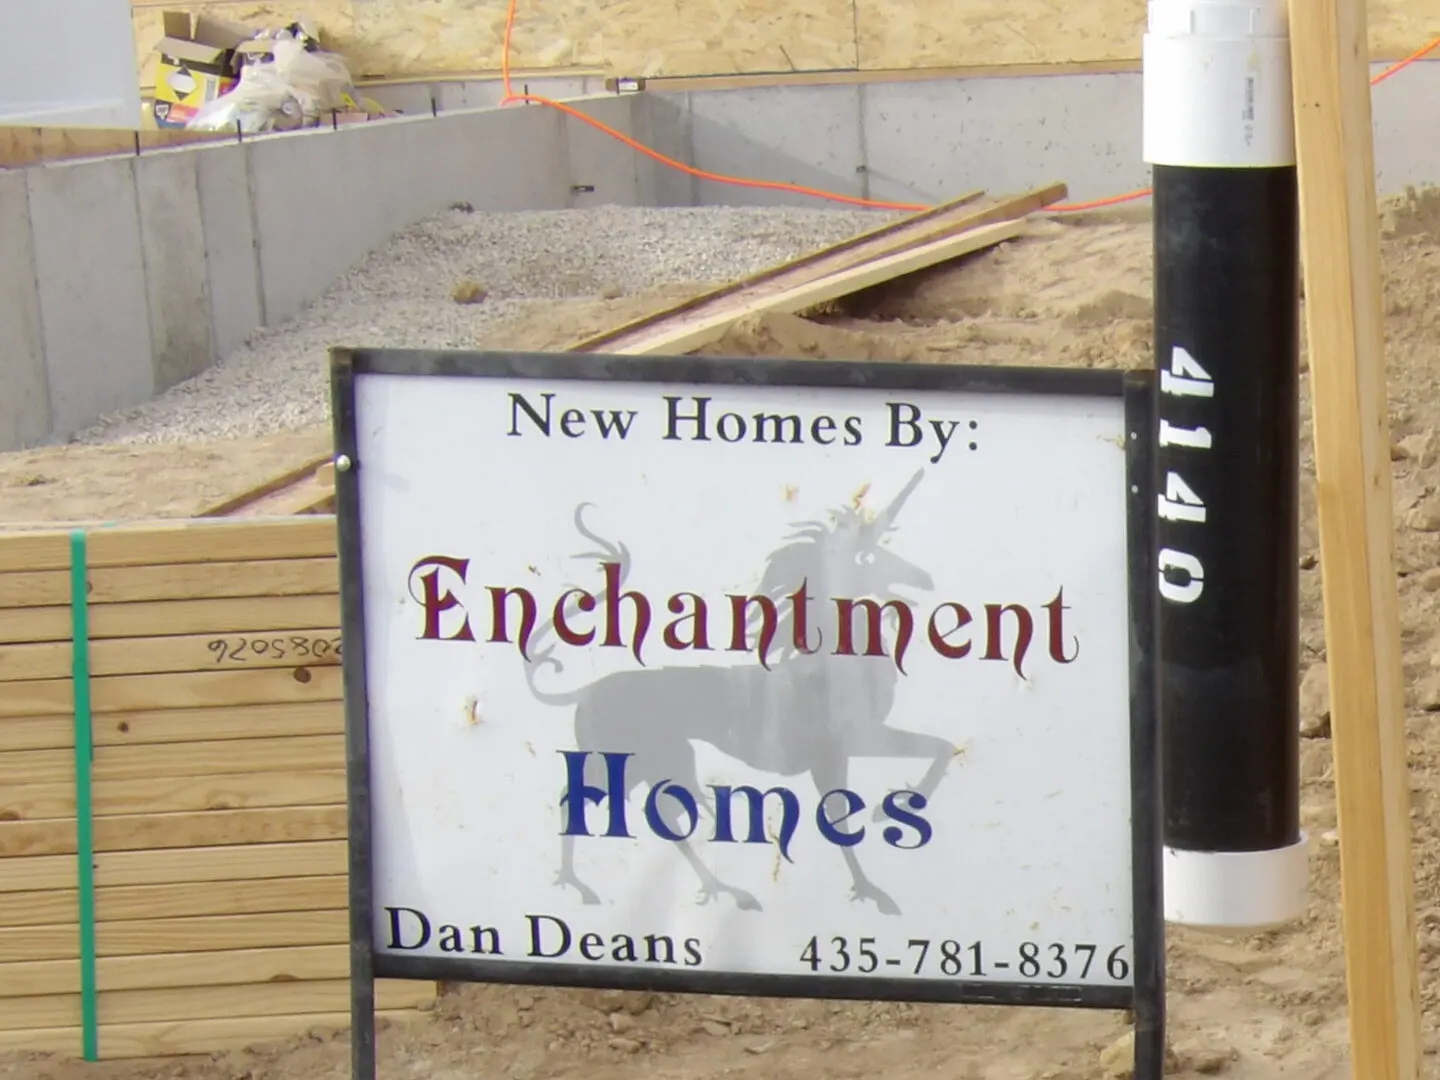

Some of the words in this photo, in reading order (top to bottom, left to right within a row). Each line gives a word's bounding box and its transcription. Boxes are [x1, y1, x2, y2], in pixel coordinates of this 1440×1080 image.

[508, 393, 638, 441] New
[662, 396, 863, 447] Homes
[886, 402, 980, 464] By:
[1157, 345, 1215, 604] 4140
[408, 555, 1080, 678] Enchantment
[556, 750, 933, 863] Homes
[385, 907, 502, 957] Dan
[525, 914, 703, 966] Deans
[800, 936, 1131, 981] 435-781-8376
